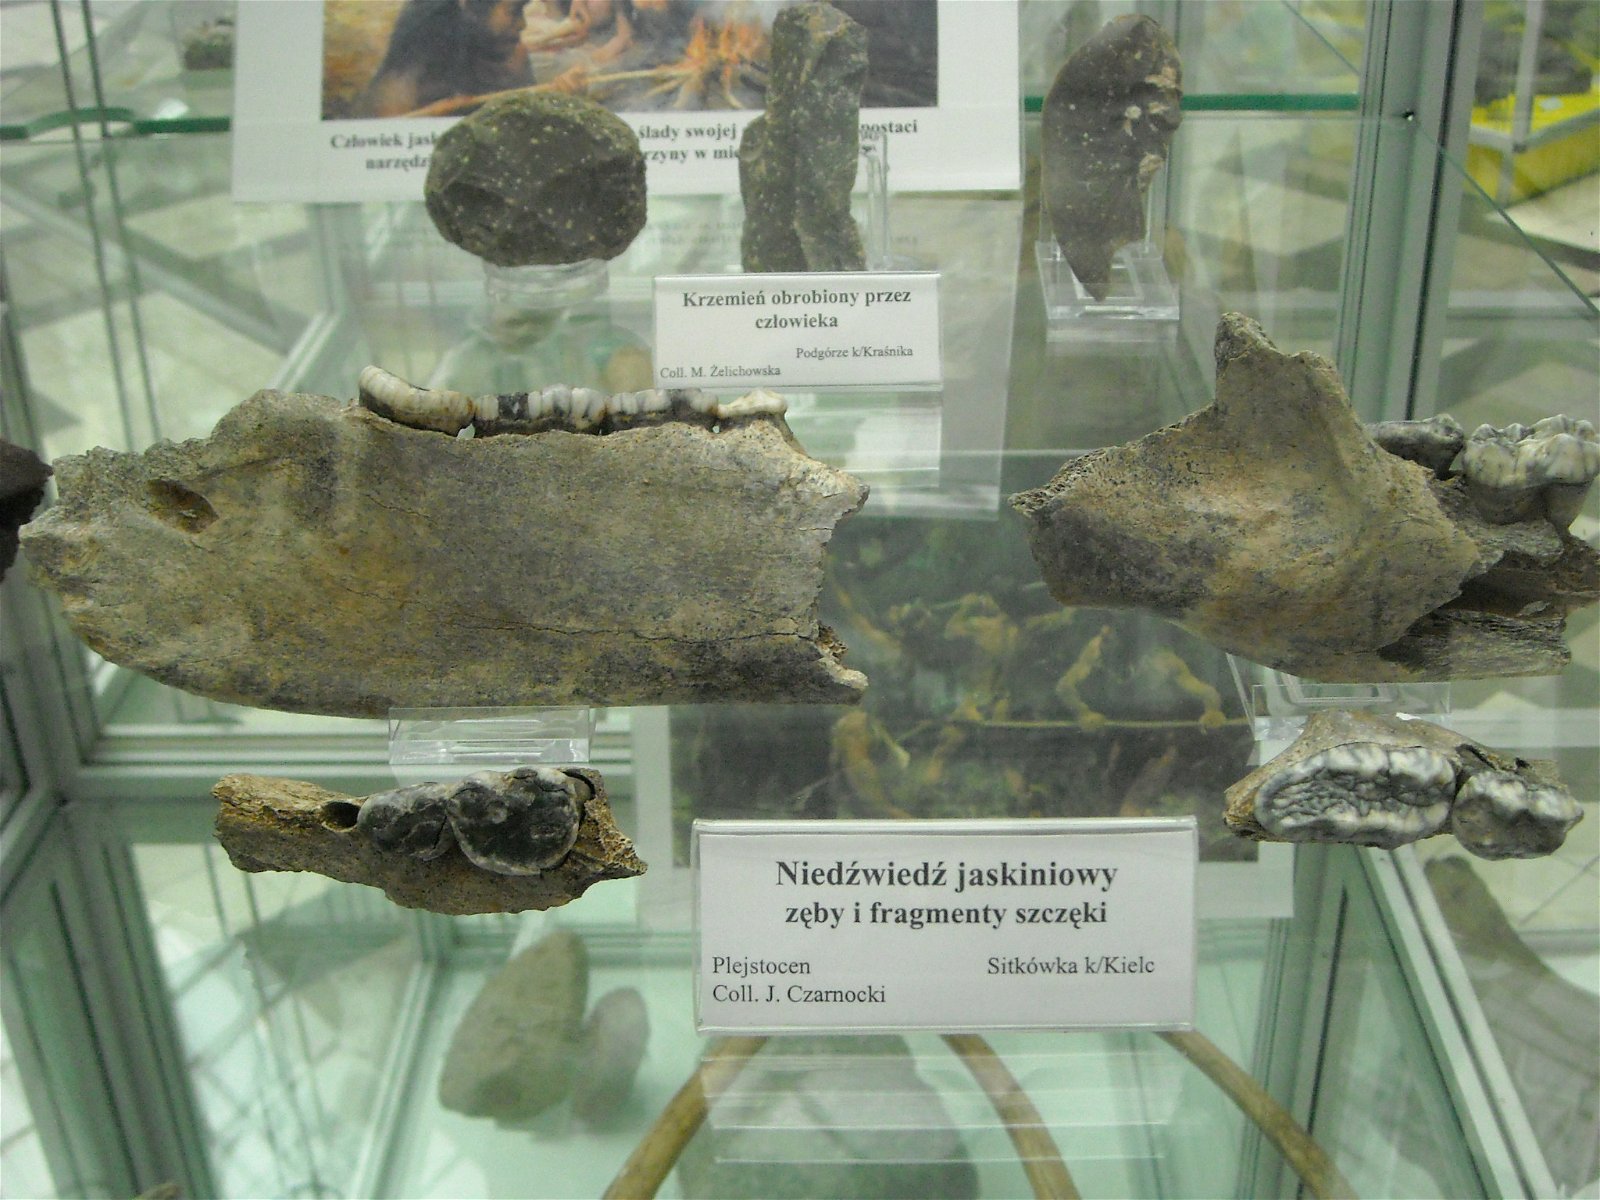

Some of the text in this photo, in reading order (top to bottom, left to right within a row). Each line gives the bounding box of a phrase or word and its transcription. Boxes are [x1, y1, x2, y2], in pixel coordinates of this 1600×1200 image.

[330, 132, 403, 149] Człowiek
[639, 124, 680, 142] ślady
[686, 122, 737, 141] swojej
[365, 153, 433, 172] narzędz
[643, 147, 688, 165] rzyny
[694, 148, 707, 160] w
[683, 288, 912, 308] Krzemień obrobiony przez
[755, 312, 839, 330] człowieka
[796, 345, 914, 361] Podgórze k/Kraśnika
[659, 363, 782, 379] Coll. M. Żelichowska
[775, 859, 1119, 893] Niedźwiedź jaskiniowy
[785, 901, 1108, 930] zęby i fragmenty szczęki
[712, 955, 811, 977] Plejstocen
[986, 954, 1156, 975] Sitkówka k/Kielc
[712, 984, 887, 1003] Coll. J. Czarnocki
